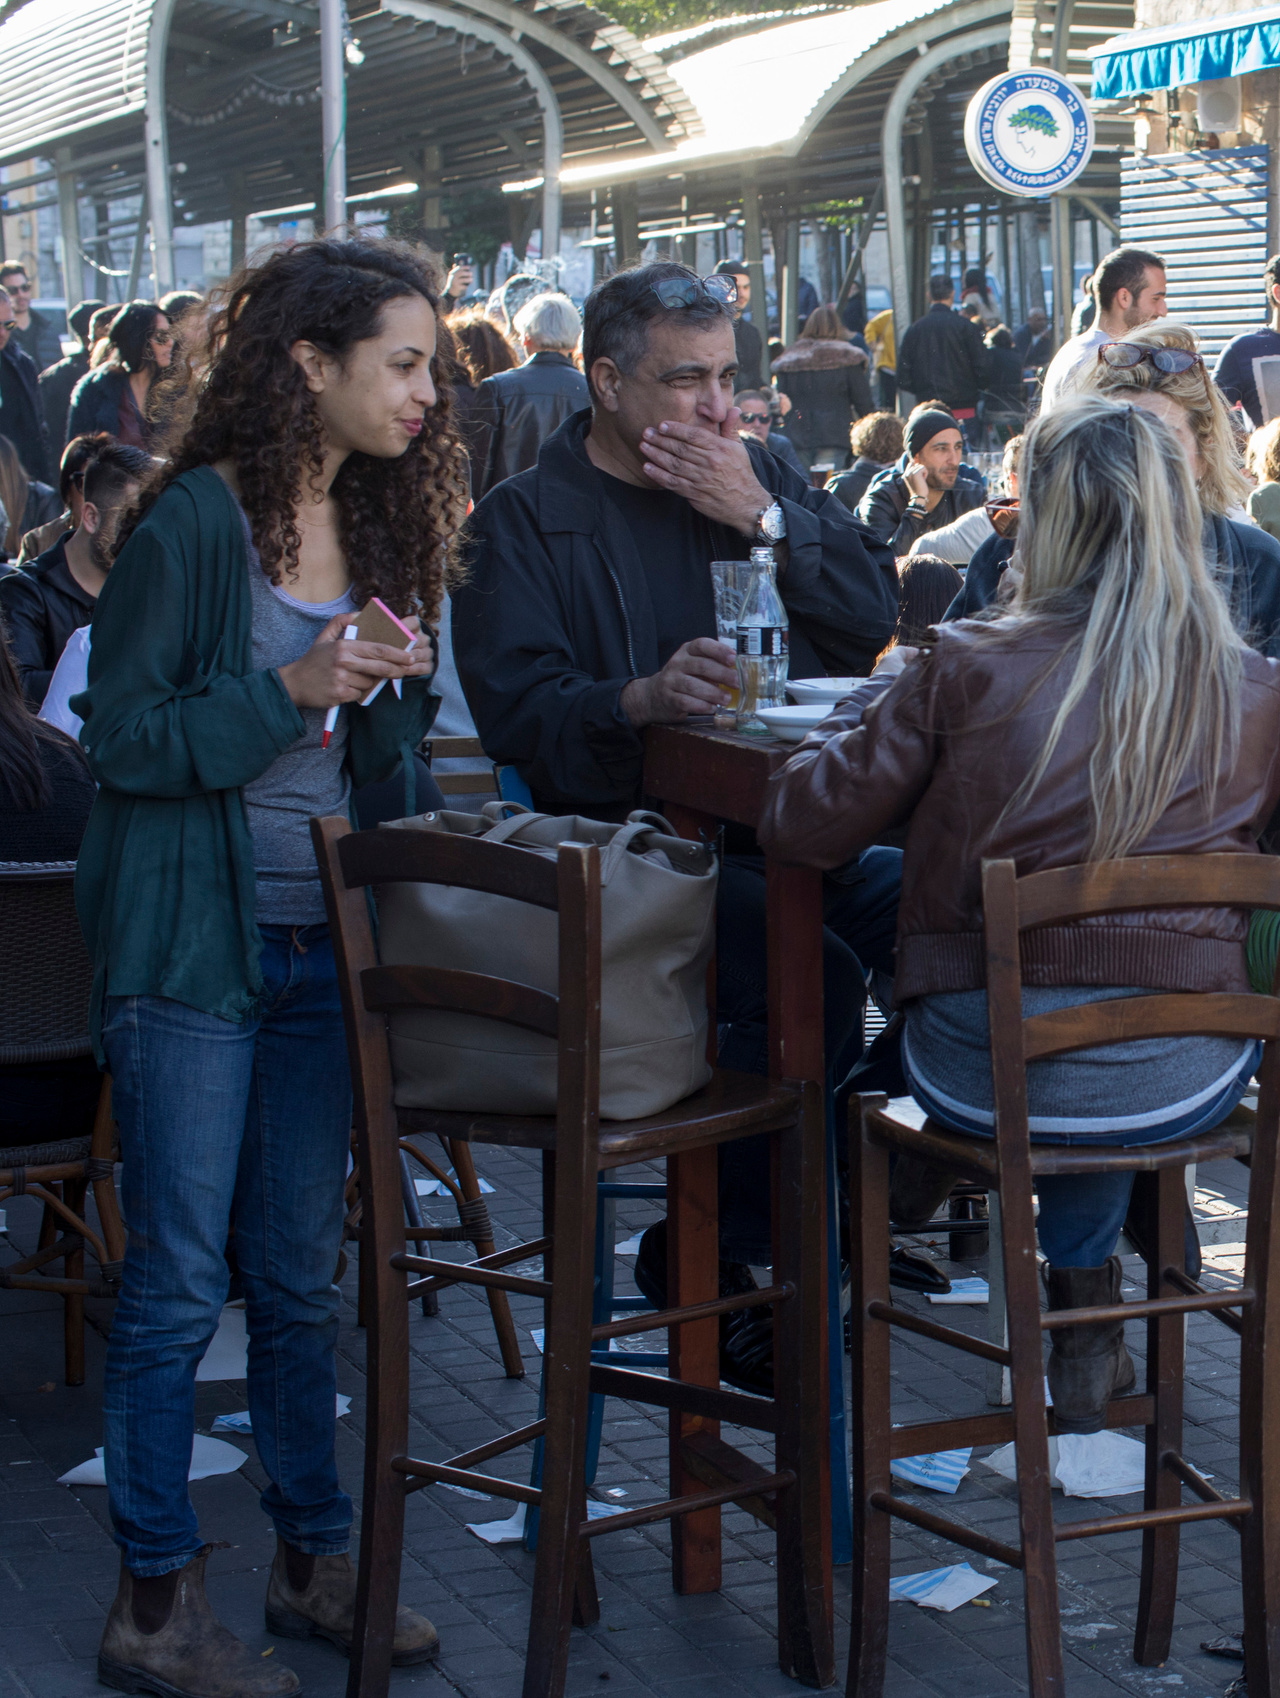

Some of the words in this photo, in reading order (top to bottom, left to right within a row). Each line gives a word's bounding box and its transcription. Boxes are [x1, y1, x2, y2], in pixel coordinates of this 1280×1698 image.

[1015, 77, 1060, 93] מסעדה
[984, 87, 1008, 121] יוונית
[1065, 94, 1080, 113] בר
[985, 145, 1006, 171] GREEK
[1005, 169, 1062, 185] RESTAURANT
[1062, 155, 1078, 173] BAR
